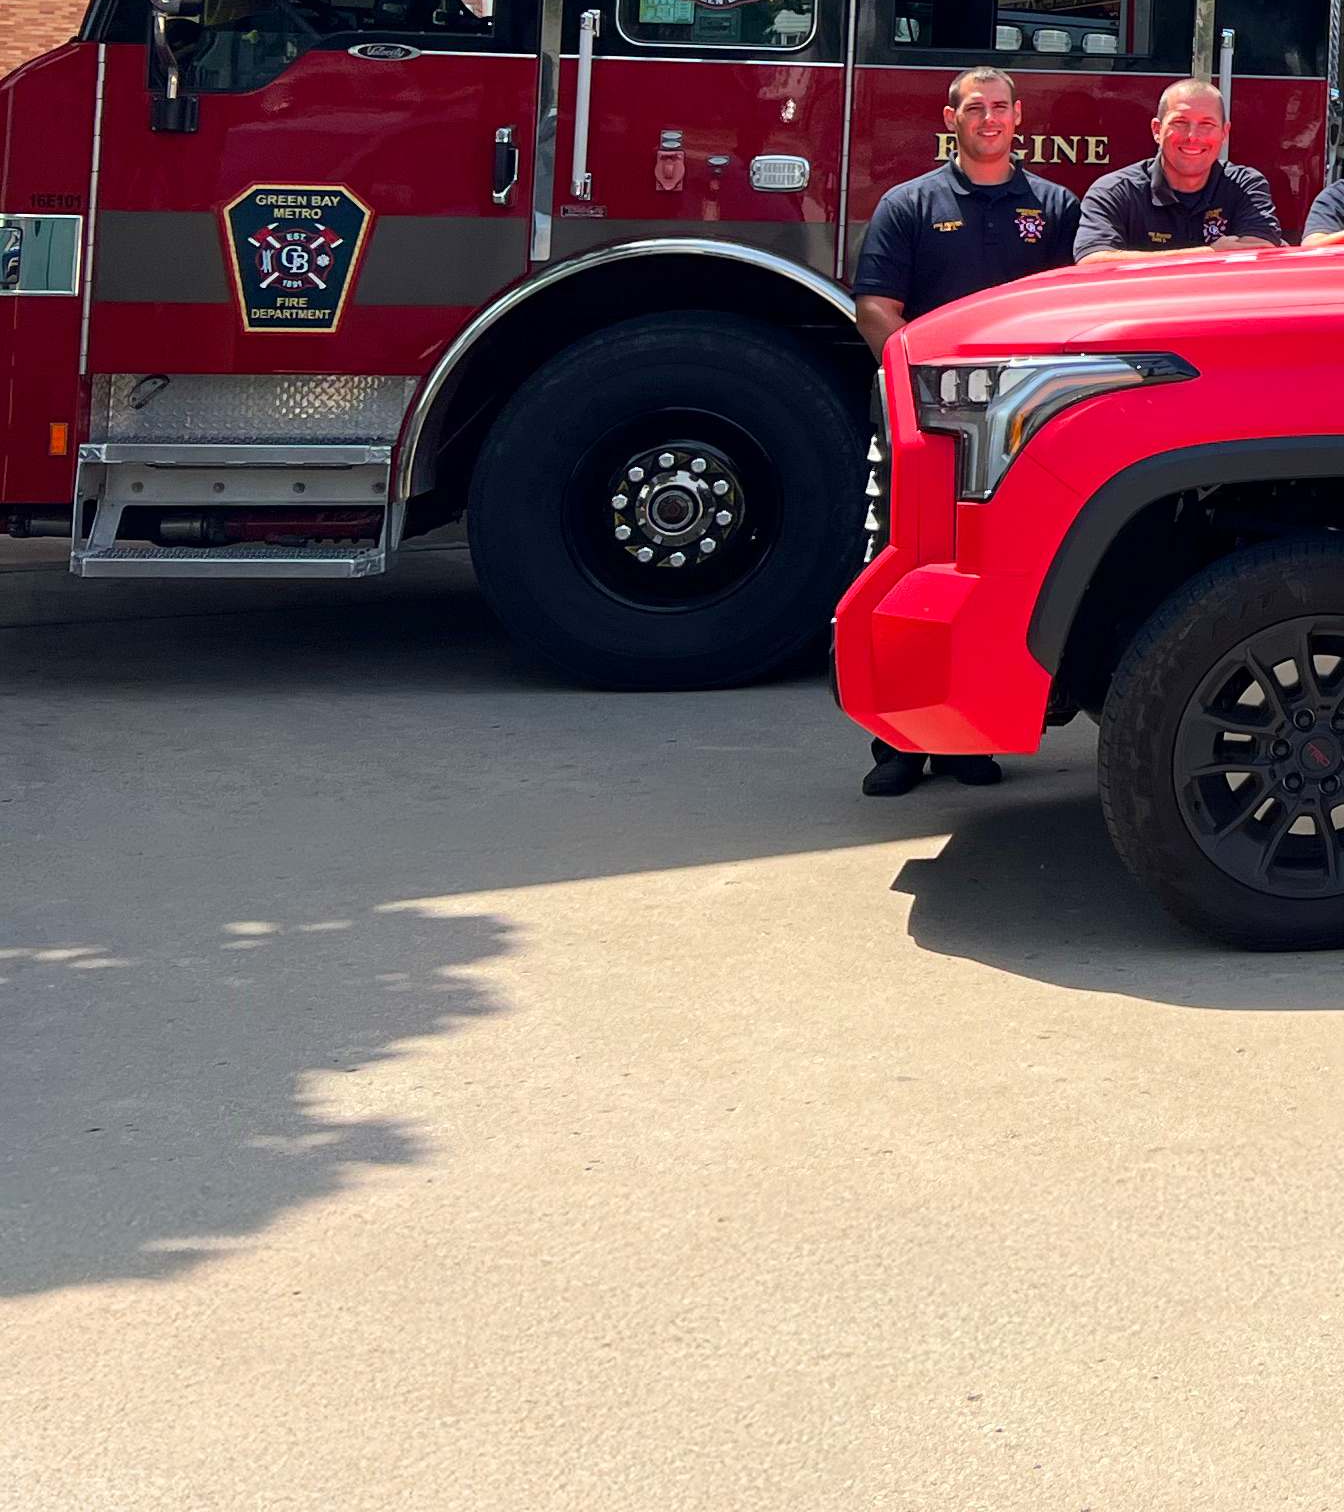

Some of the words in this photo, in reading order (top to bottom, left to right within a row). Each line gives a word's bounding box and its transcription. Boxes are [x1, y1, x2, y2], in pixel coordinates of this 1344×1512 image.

[934, 133, 1110, 164] EGINE
[256, 194, 307, 206] GREEN
[311, 196, 341, 206] BAY
[273, 208, 322, 219] METRO
[276, 297, 308, 308] FIRE
[250, 308, 332, 320] DEPARTMENT
